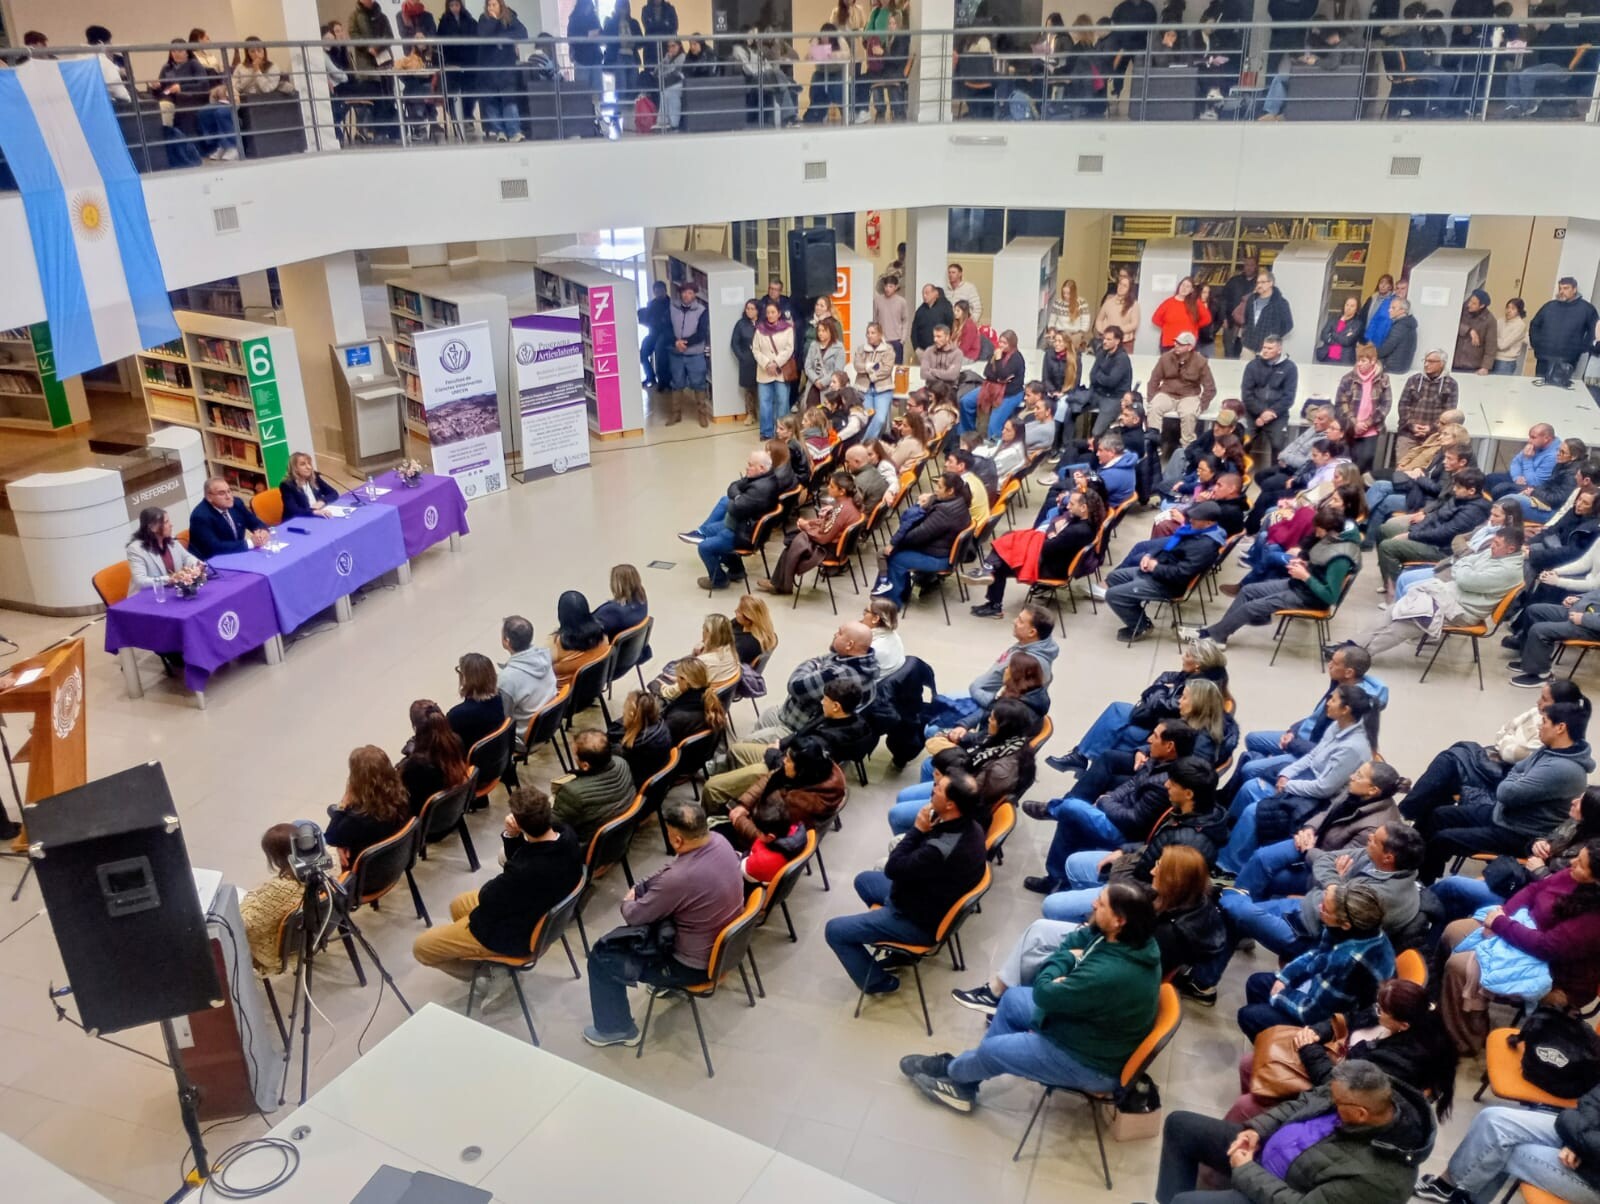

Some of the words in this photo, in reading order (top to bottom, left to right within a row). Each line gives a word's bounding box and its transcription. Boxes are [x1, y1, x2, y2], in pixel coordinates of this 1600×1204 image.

[593, 292, 610, 320] 7
[250, 344, 270, 376] 6
[537, 345, 580, 361] Articulatorio
[140, 479, 180, 502] REFERENCIA
